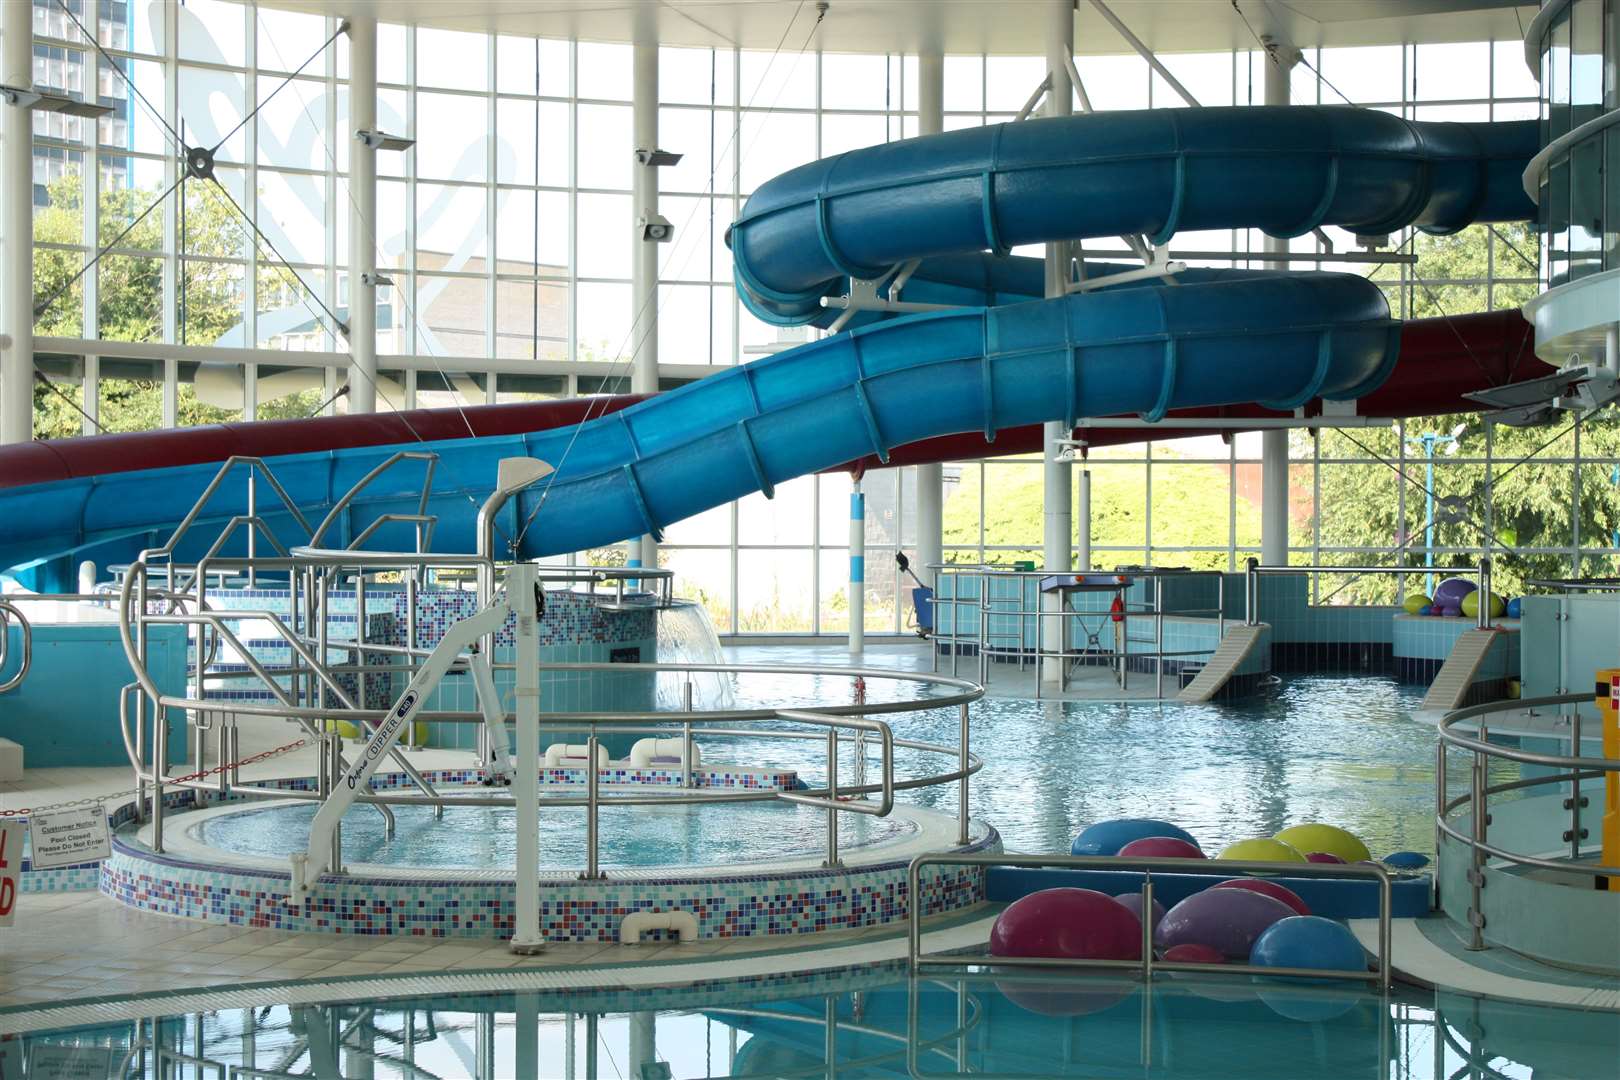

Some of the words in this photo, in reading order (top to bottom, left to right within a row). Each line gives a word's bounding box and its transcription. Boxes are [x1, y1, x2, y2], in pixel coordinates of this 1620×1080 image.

[370, 719, 398, 755] DIPPER
[41, 823, 74, 833] Customer
[75, 820, 97, 829] Notice
[67, 832, 91, 841] Closed
[38, 845, 61, 853] Please
[87, 838, 105, 846] Enter
